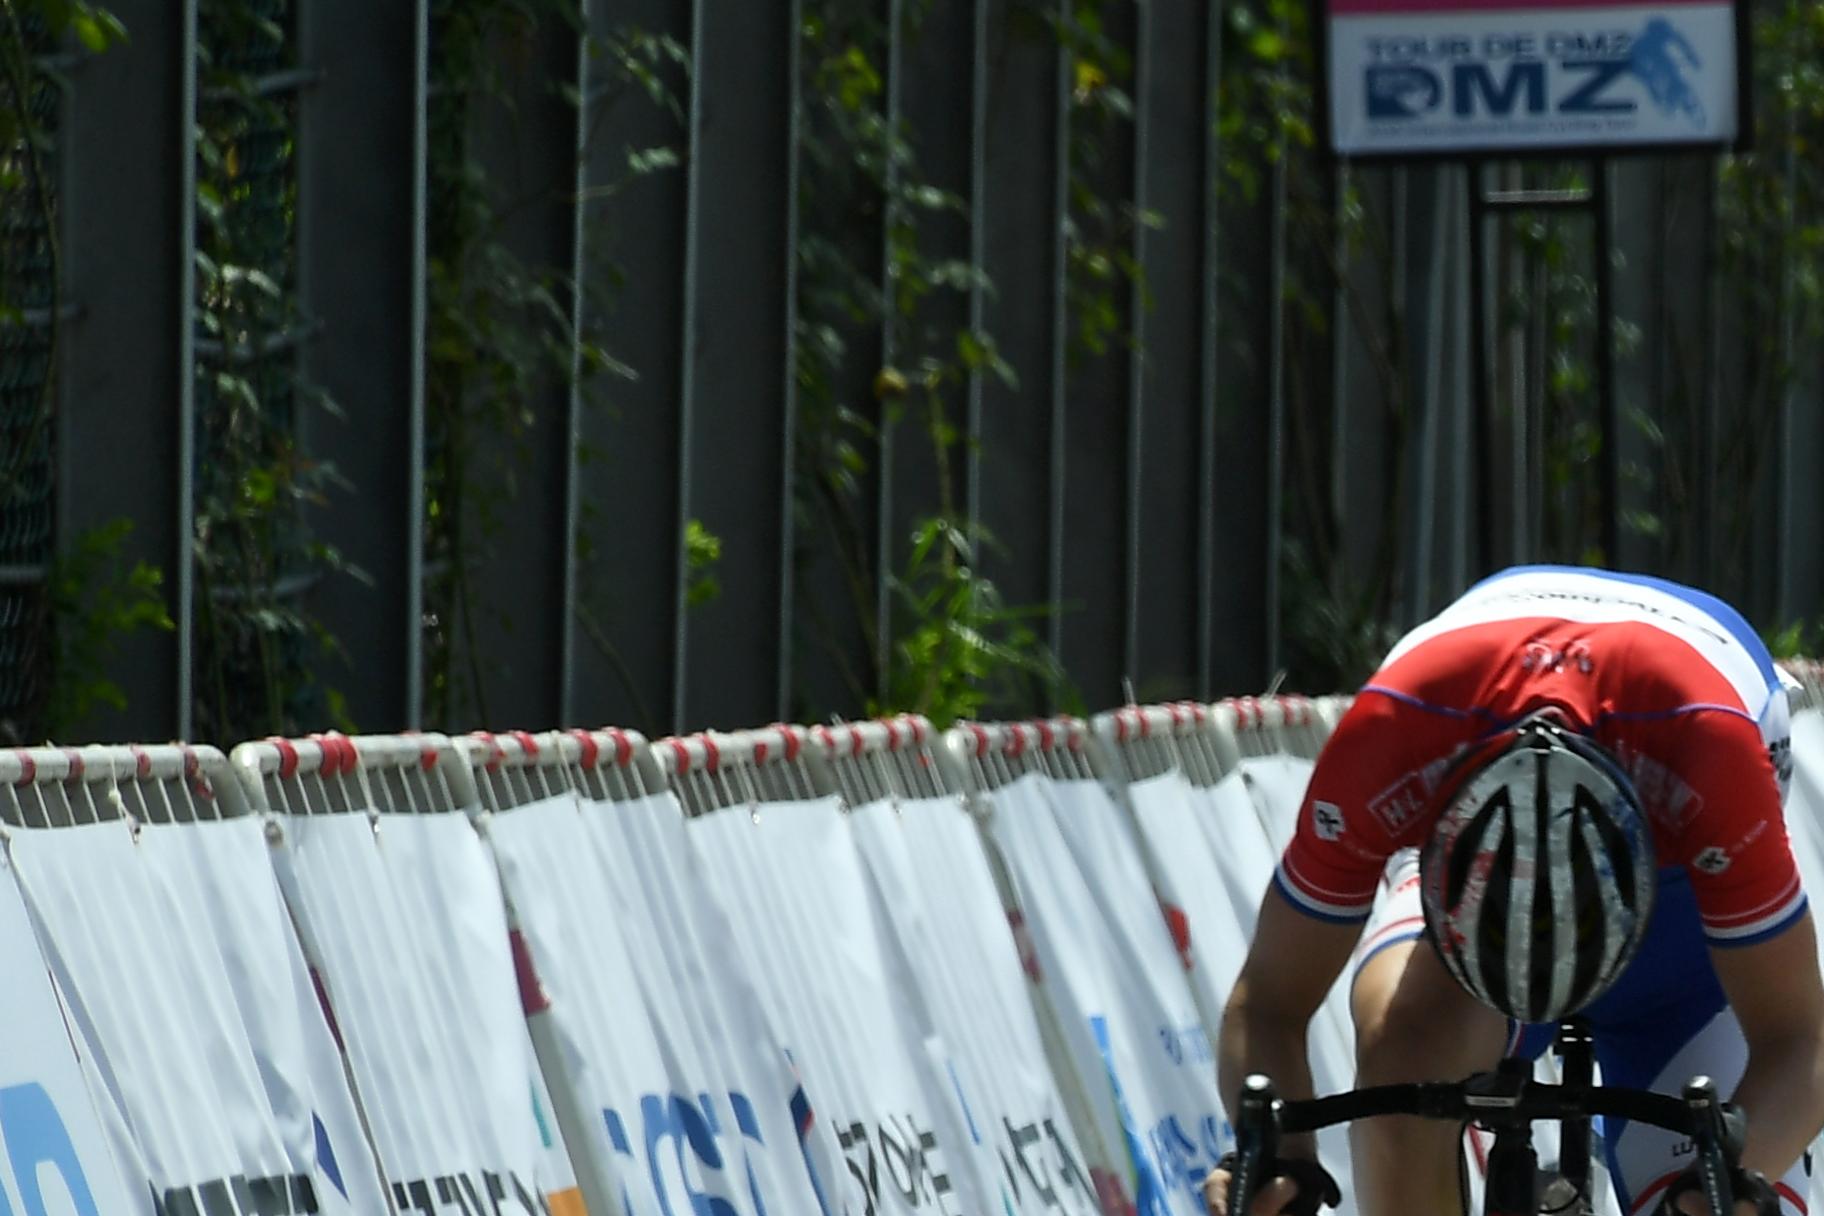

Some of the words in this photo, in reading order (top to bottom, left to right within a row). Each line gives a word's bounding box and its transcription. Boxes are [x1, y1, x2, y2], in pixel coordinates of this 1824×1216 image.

[1366, 34, 1470, 59] TOUR
[1484, 32, 1534, 57] DE
[1547, 30, 1631, 55] DMZ
[1365, 60, 1638, 119] DMZ
